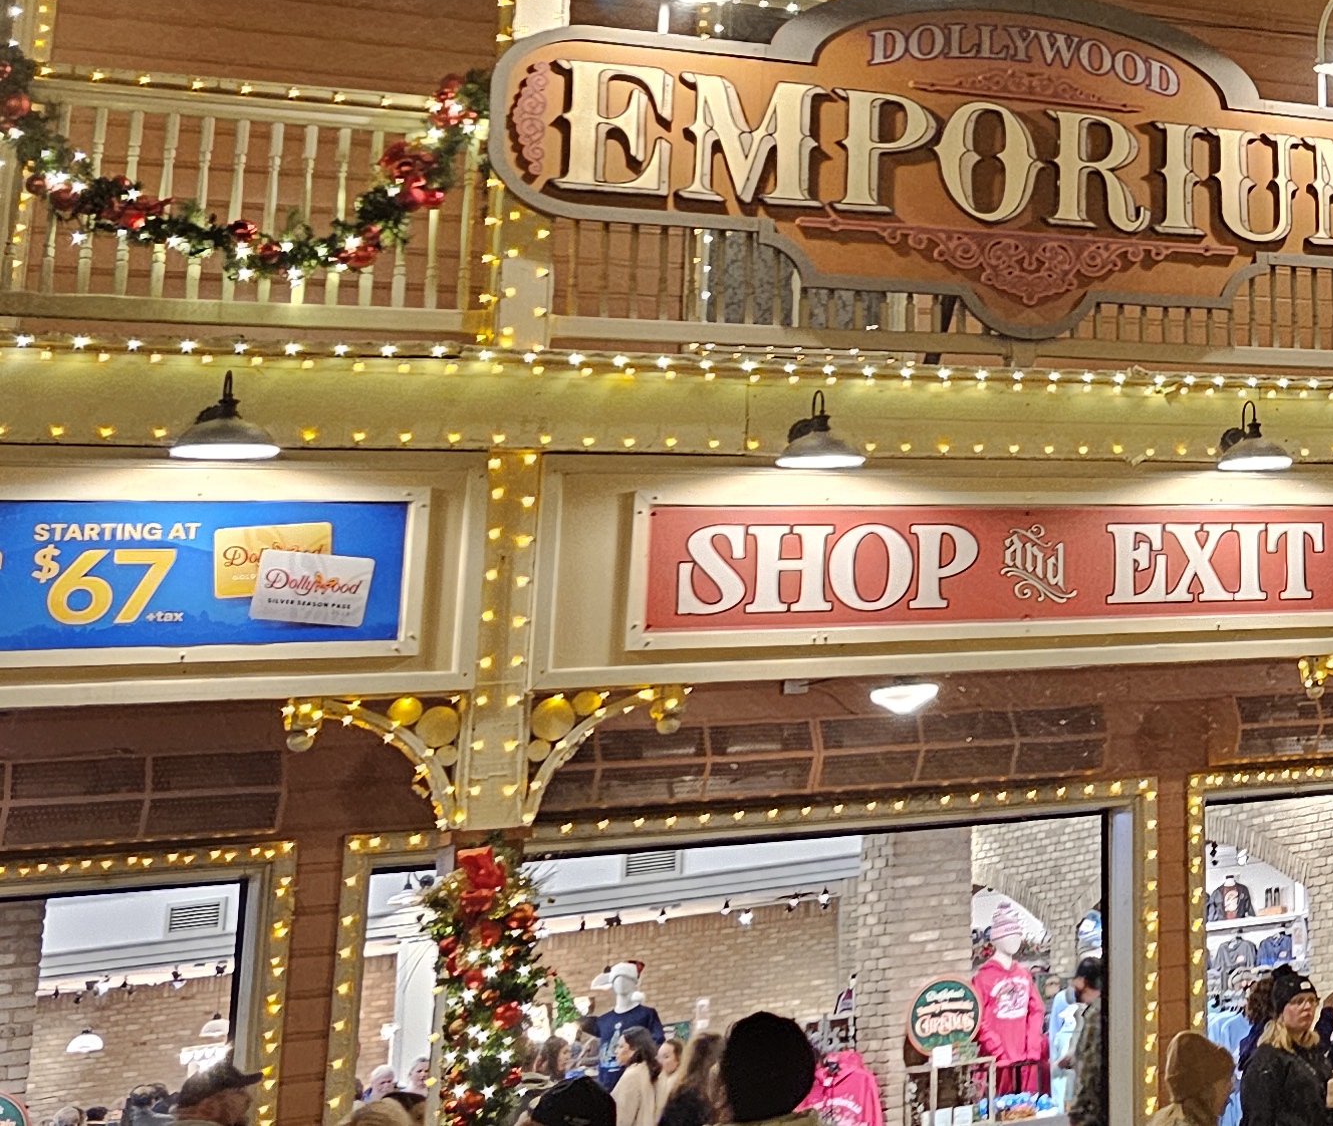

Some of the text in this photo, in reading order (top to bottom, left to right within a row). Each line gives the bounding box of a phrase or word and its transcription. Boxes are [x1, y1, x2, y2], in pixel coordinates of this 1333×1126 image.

[868, 23, 1180, 97] DOLLYWOOD
[33, 523, 202, 541] STARTING AT
[677, 522, 1325, 615] SHOP and EXIT
[31, 544, 178, 625] $67
[145, 611, 184, 623] +tax
